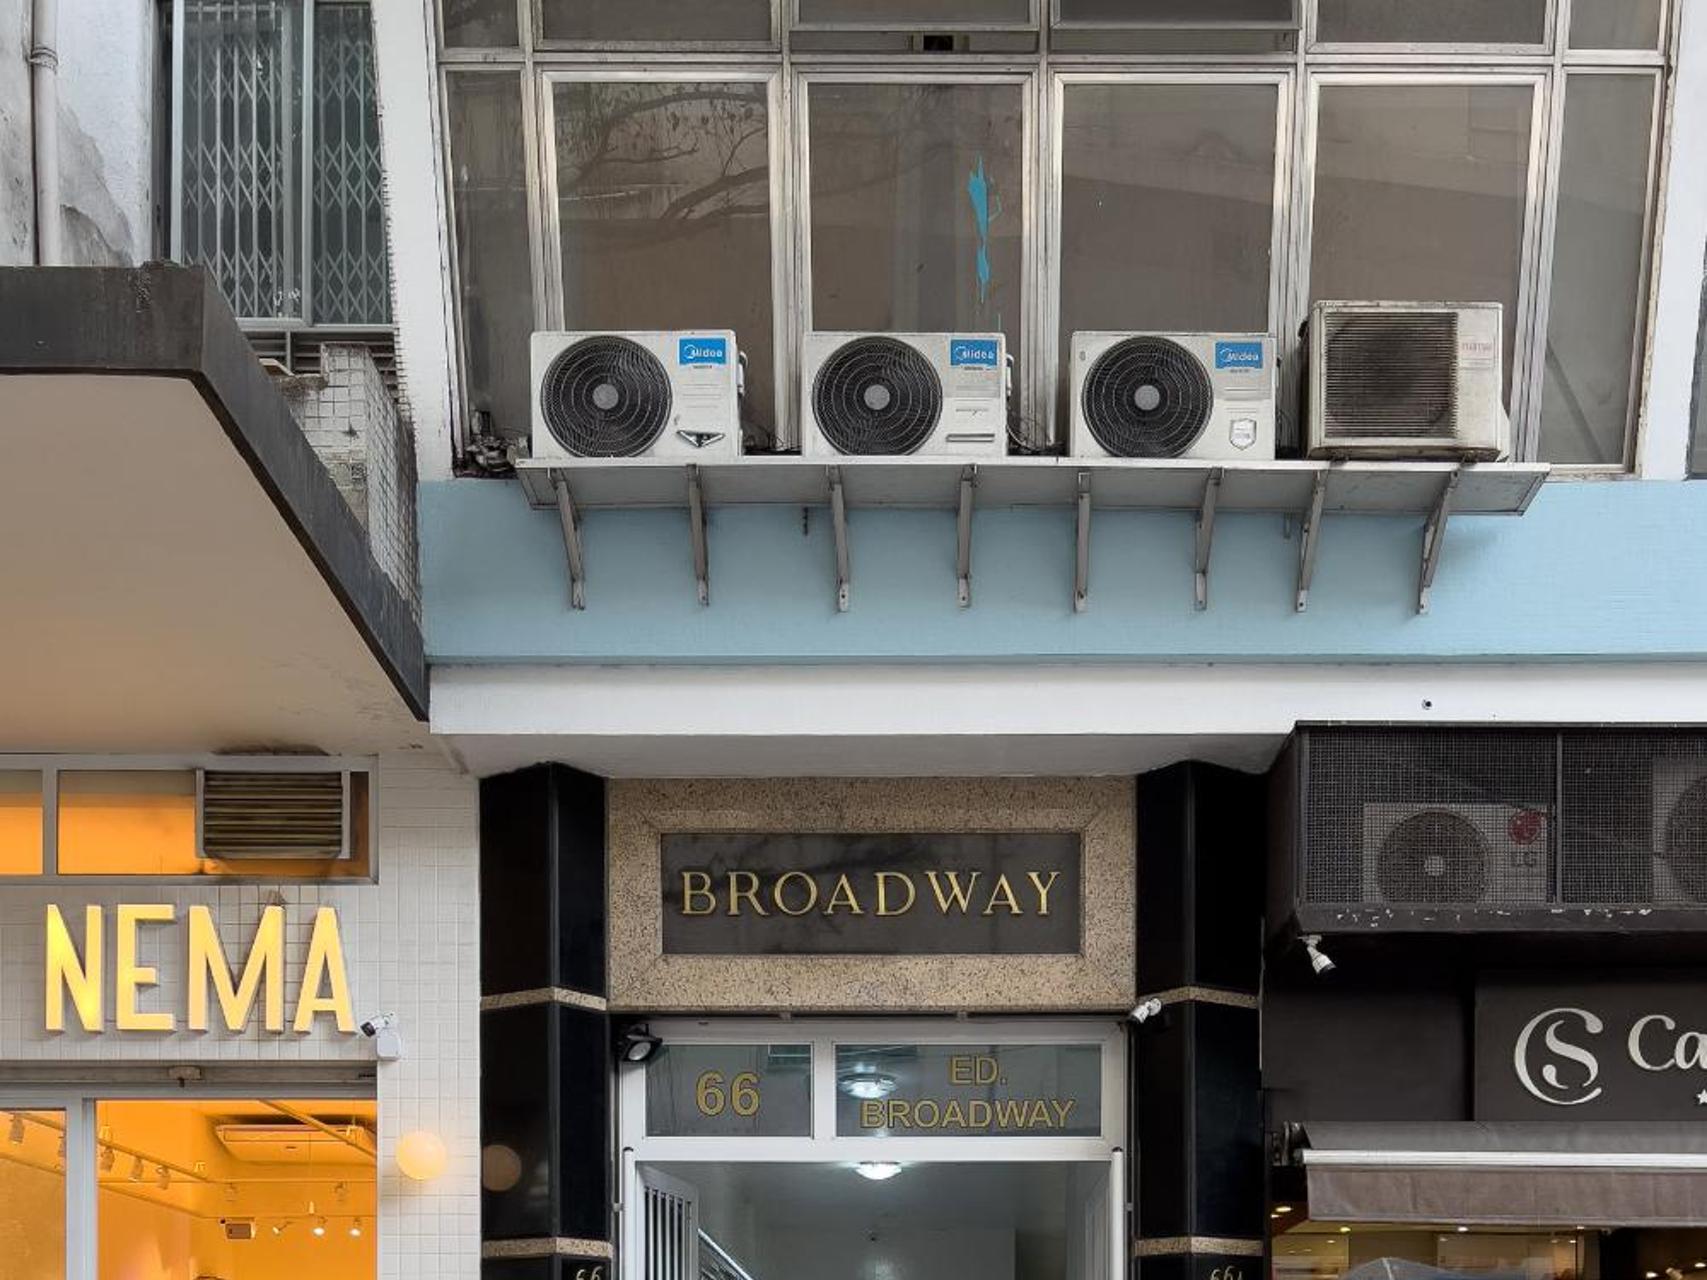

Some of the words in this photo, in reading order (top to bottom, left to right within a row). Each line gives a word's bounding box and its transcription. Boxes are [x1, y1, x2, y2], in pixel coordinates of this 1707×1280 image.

[681, 871, 1061, 916] BROADWAY
[45, 904, 357, 1033] NEMA
[950, 1055, 1008, 1086] ED.
[697, 1070, 761, 1117] 66
[860, 1099, 1075, 1129] BROADWAY
